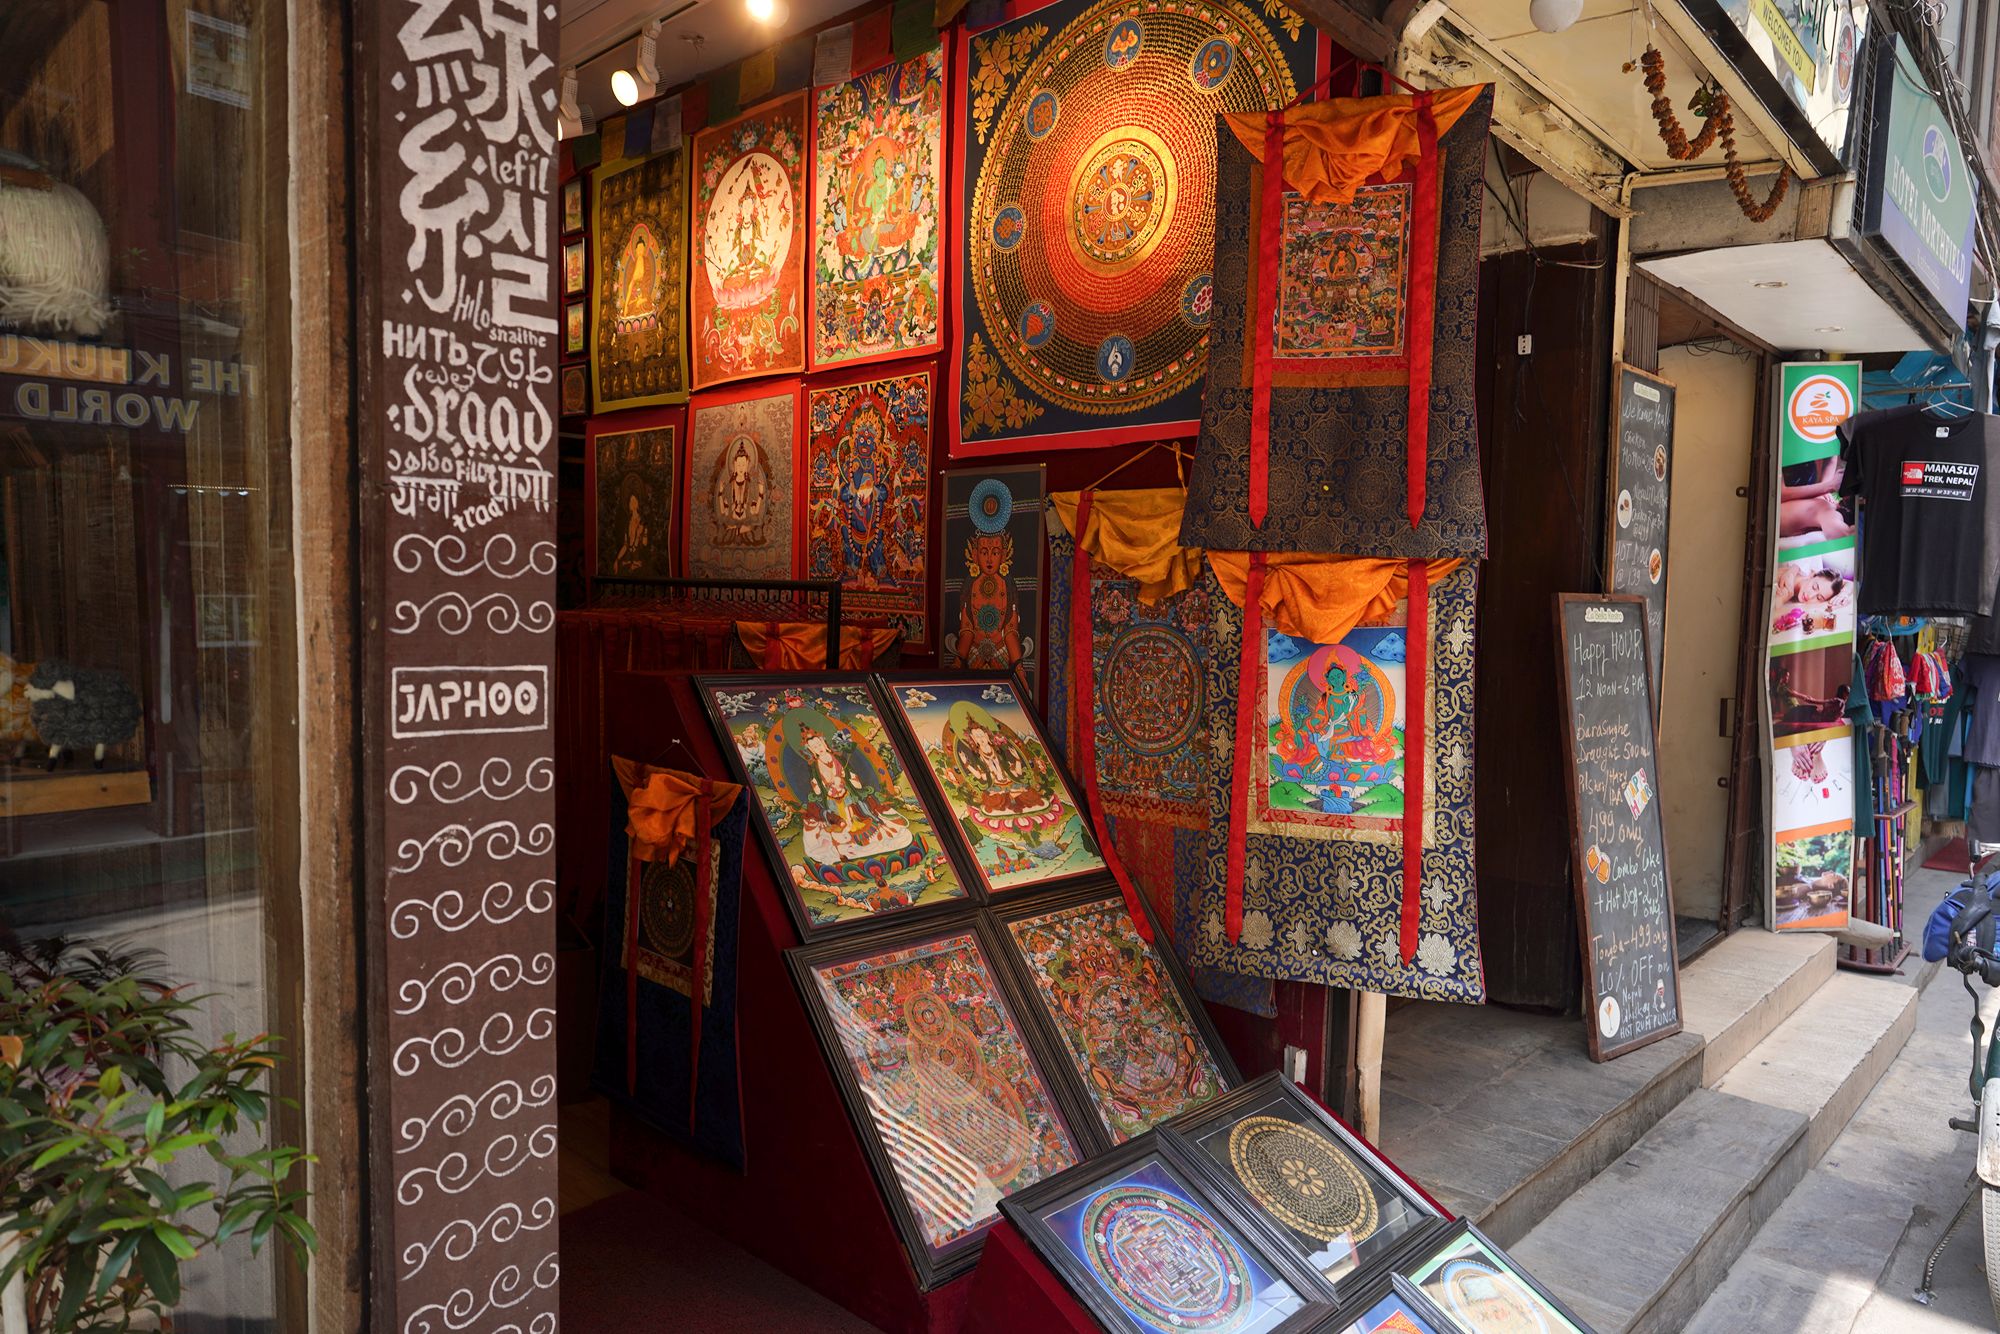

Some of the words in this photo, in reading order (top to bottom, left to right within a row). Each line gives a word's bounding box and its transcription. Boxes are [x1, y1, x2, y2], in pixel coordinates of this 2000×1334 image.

[1762, 5, 1792, 55] WELCOMES
[1792, 46, 1803, 71] YOU
[1891, 155, 1918, 227] HOTEL
[1920, 199, 1965, 285] NORTHFIELD
[479, 189, 558, 334] 실
[1802, 416, 1823, 424] KAYA
[1825, 416, 1839, 424] SPA
[1924, 463, 1977, 476] MANASLU
[1946, 476, 1973, 486] NEPAL
[1573, 632, 1609, 678] Happy
[399, 680, 538, 723] JAPHOO
[1576, 673, 1593, 701] 12
[1622, 741, 1640, 760] 500
[1588, 807, 1615, 845] 499
[1630, 953, 1653, 988] OFF
